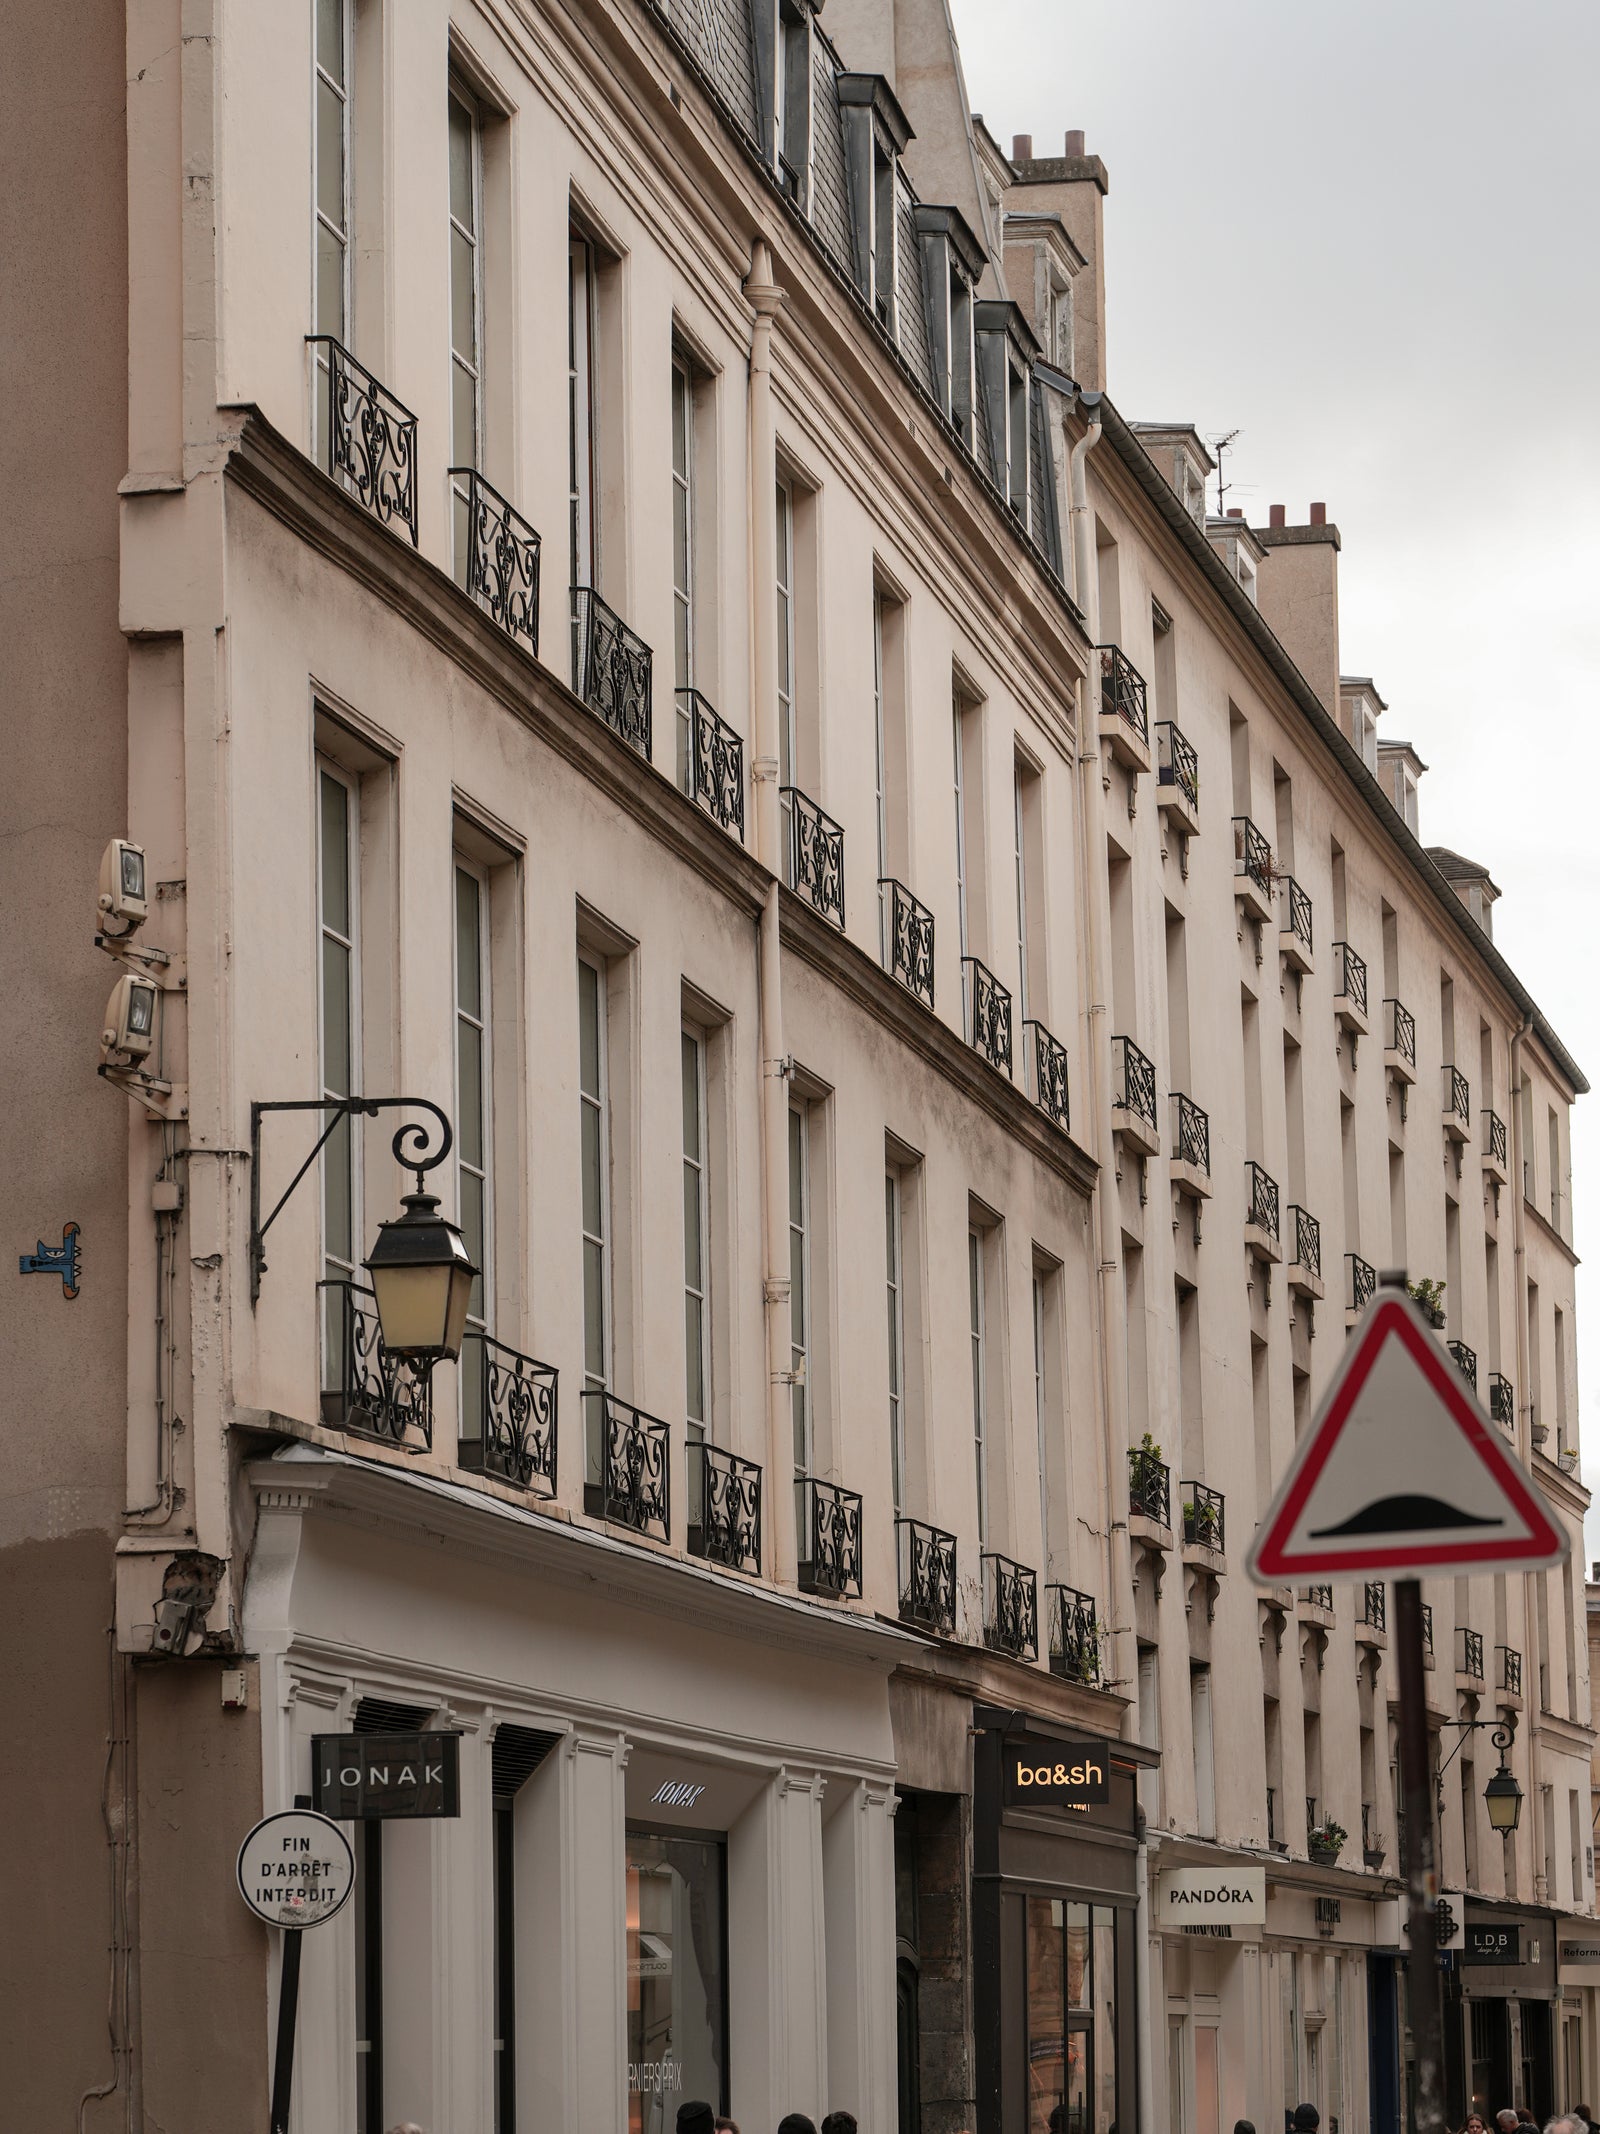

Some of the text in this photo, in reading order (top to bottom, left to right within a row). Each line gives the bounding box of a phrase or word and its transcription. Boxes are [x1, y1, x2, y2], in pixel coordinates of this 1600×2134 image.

[322, 1765, 443, 1787] JONAK
[1017, 1760, 1102, 1786] ba&sh
[651, 1780, 706, 1807] JONAK
[283, 1838, 310, 1851] FIN
[261, 1860, 331, 1876] D'ARRÊT
[256, 1888, 336, 1902] INTERDIT
[1170, 1886, 1254, 1903] PANDORA
[1474, 1934, 1508, 1946] L.D.B
[662, 2062, 682, 2091] PRIX
